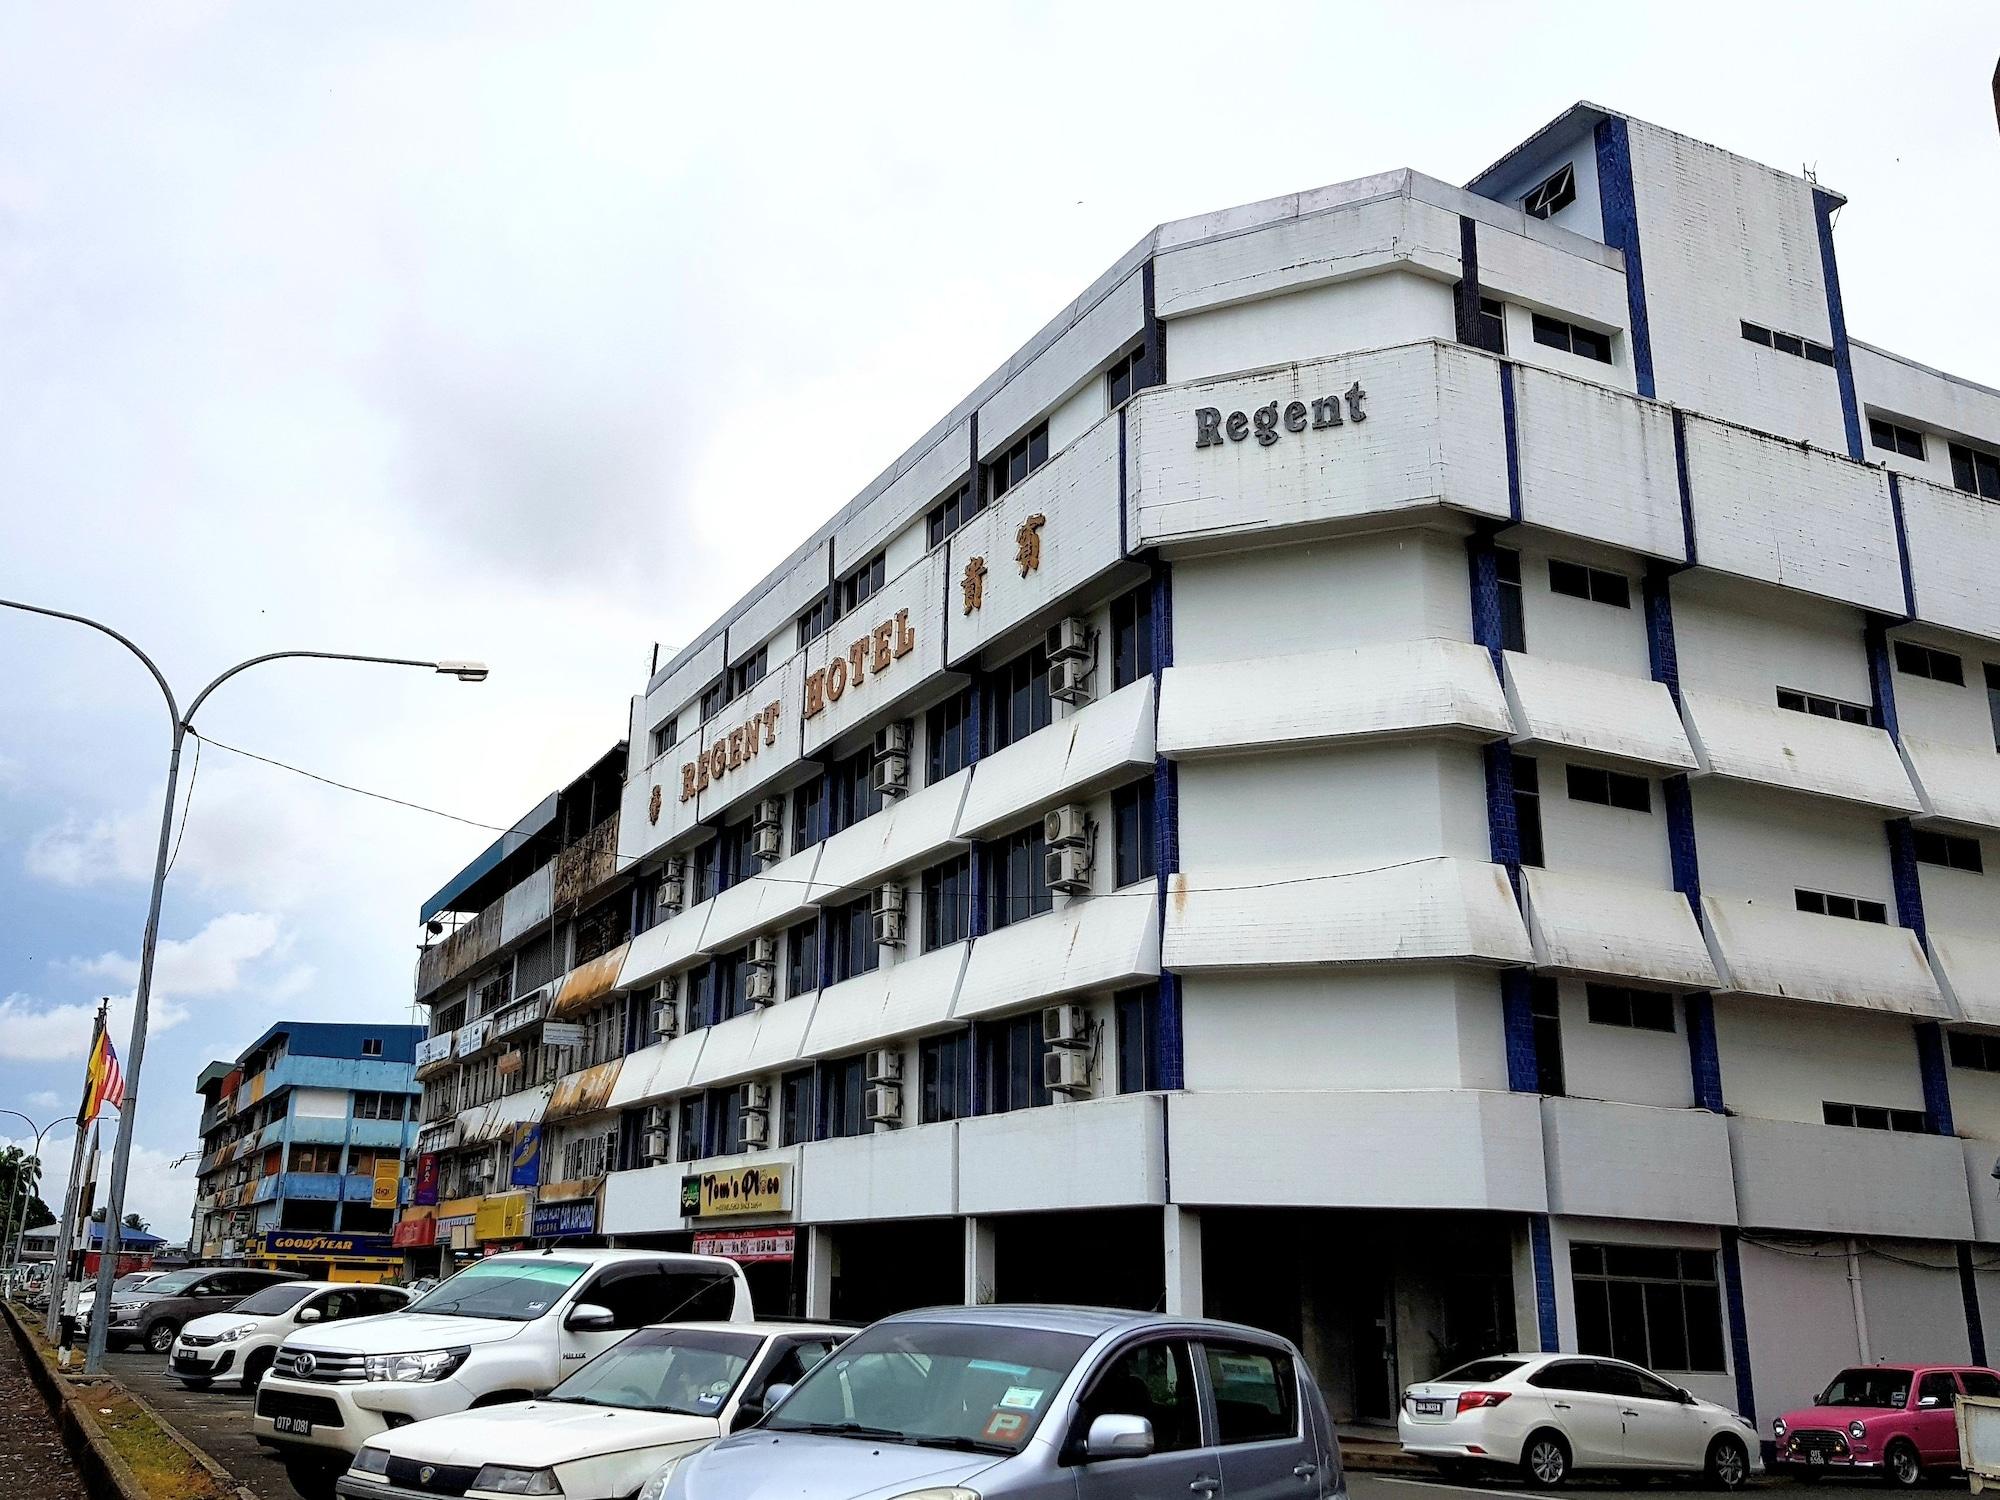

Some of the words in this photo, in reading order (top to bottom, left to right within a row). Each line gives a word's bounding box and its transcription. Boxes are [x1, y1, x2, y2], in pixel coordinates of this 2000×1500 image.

[1195, 381, 1367, 448] Regent
[679, 700, 781, 802] REGENT
[803, 607, 915, 719] HOTEL
[375, 1186, 390, 1196] digi
[703, 1174, 739, 1207] Tom's
[275, 1236, 353, 1251] GOODYEAR
[277, 1416, 291, 1430] QTP
[292, 1418, 309, 1433] 1081
